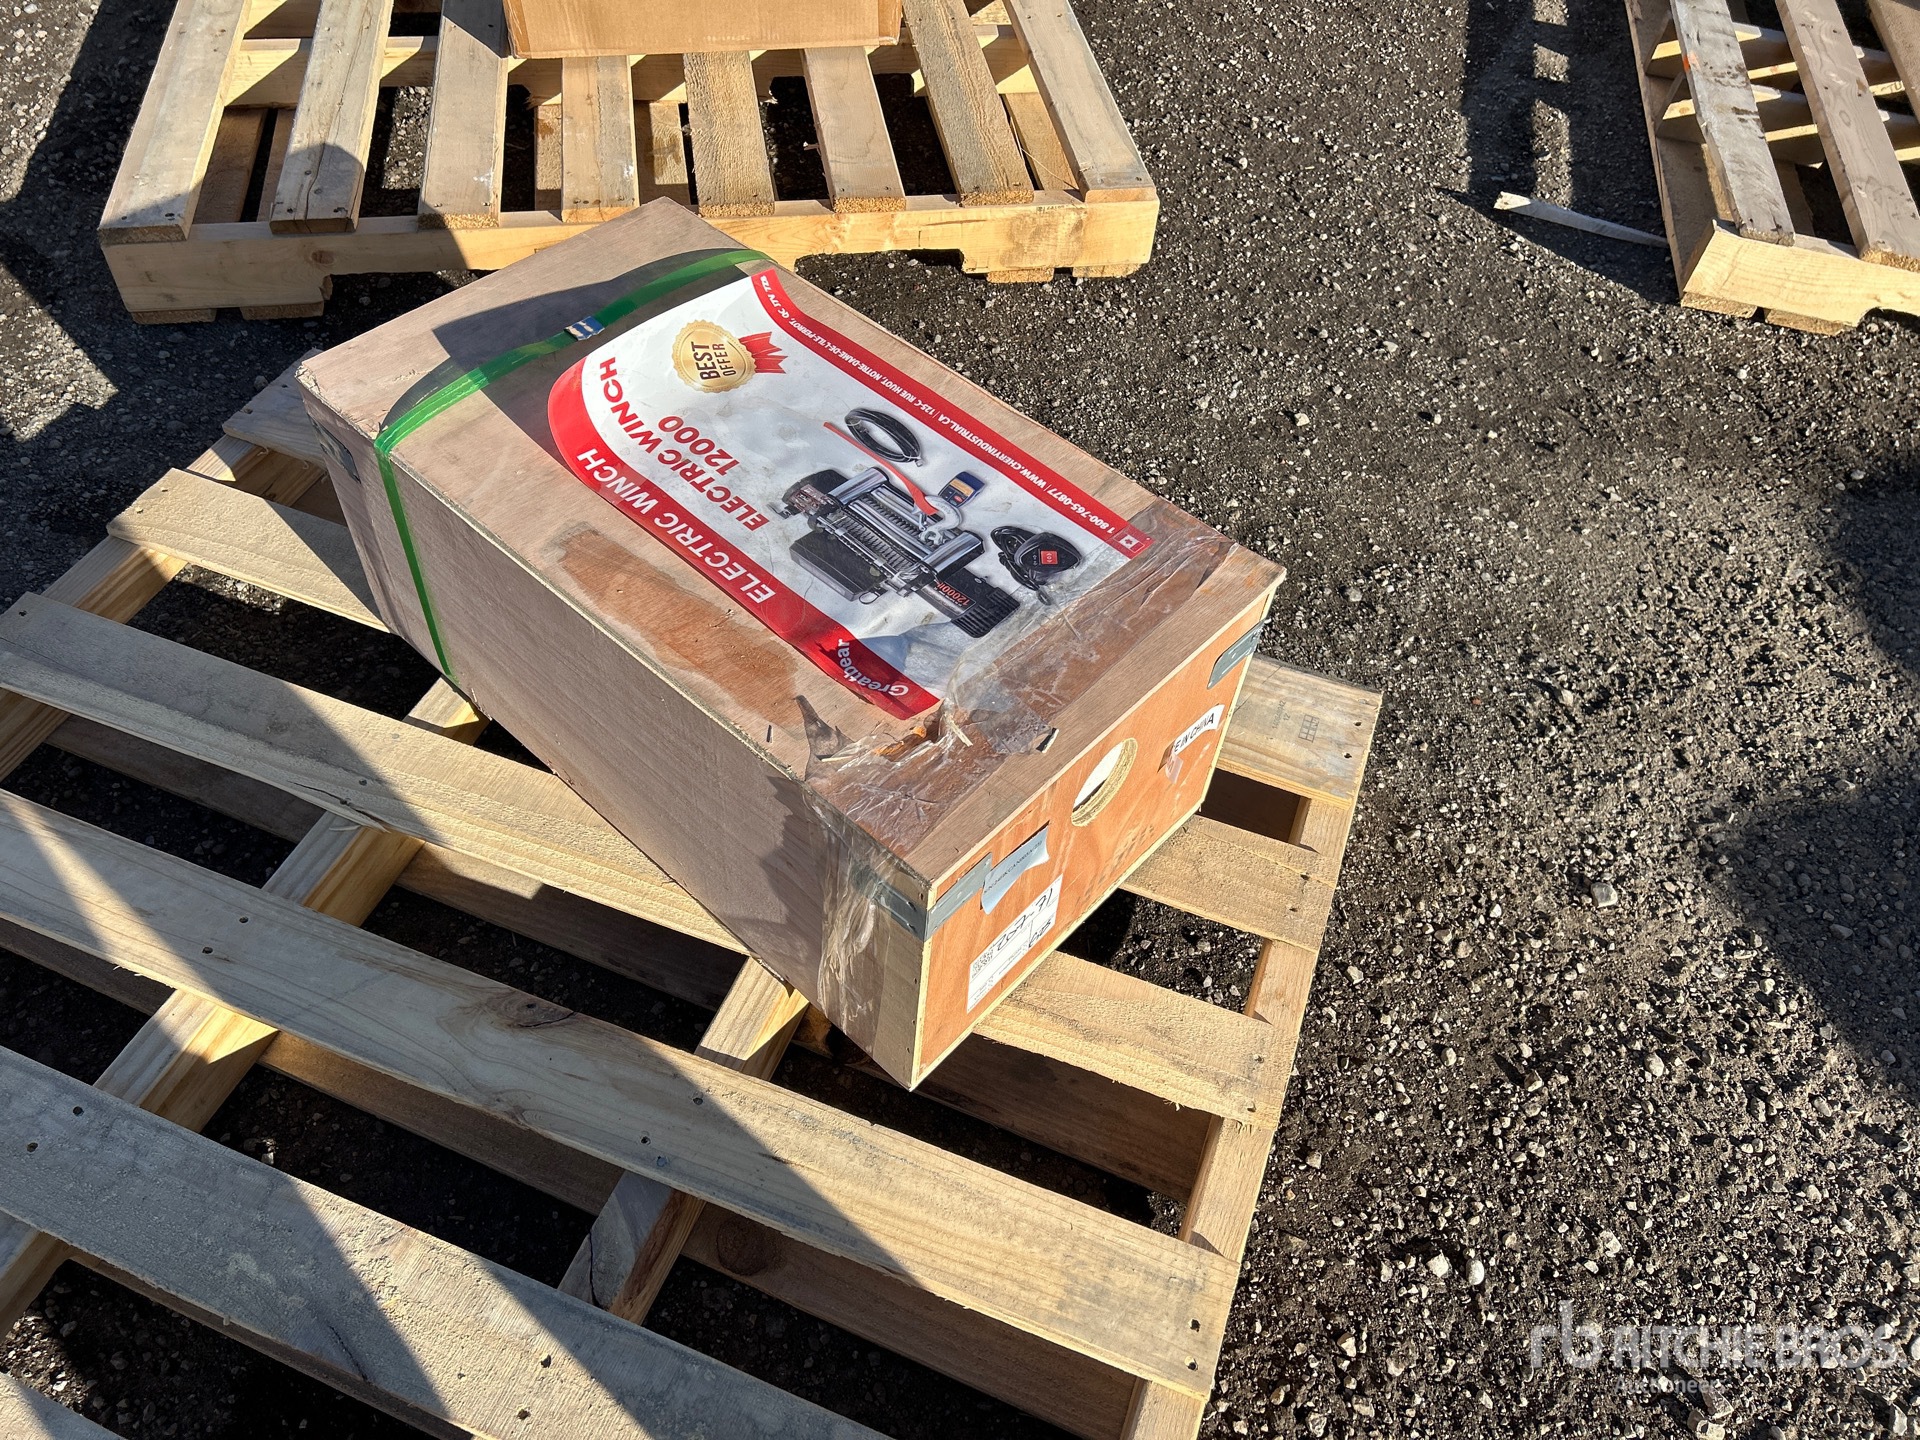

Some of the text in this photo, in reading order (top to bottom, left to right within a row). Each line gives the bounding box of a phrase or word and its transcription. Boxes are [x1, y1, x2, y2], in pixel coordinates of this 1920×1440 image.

[777, 307, 790, 319] QC
[690, 341, 721, 381] BEST
[711, 343, 737, 377] OFFER
[880, 376, 903, 393] HUOT,
[899, 389, 917, 403] RUE
[913, 399, 936, 416] 125-C
[599, 356, 770, 532] ELECTRIC WINCH
[658, 415, 741, 477] 12000
[937, 413, 1047, 489] WWW.CHERYINDUSTRIAL.CA
[576, 448, 777, 604] ELECTRIC WINCH
[1046, 487, 1110, 530] 800-765-0877
[1106, 526, 1116, 535] 1
[837, 638, 910, 696] Greatbear
